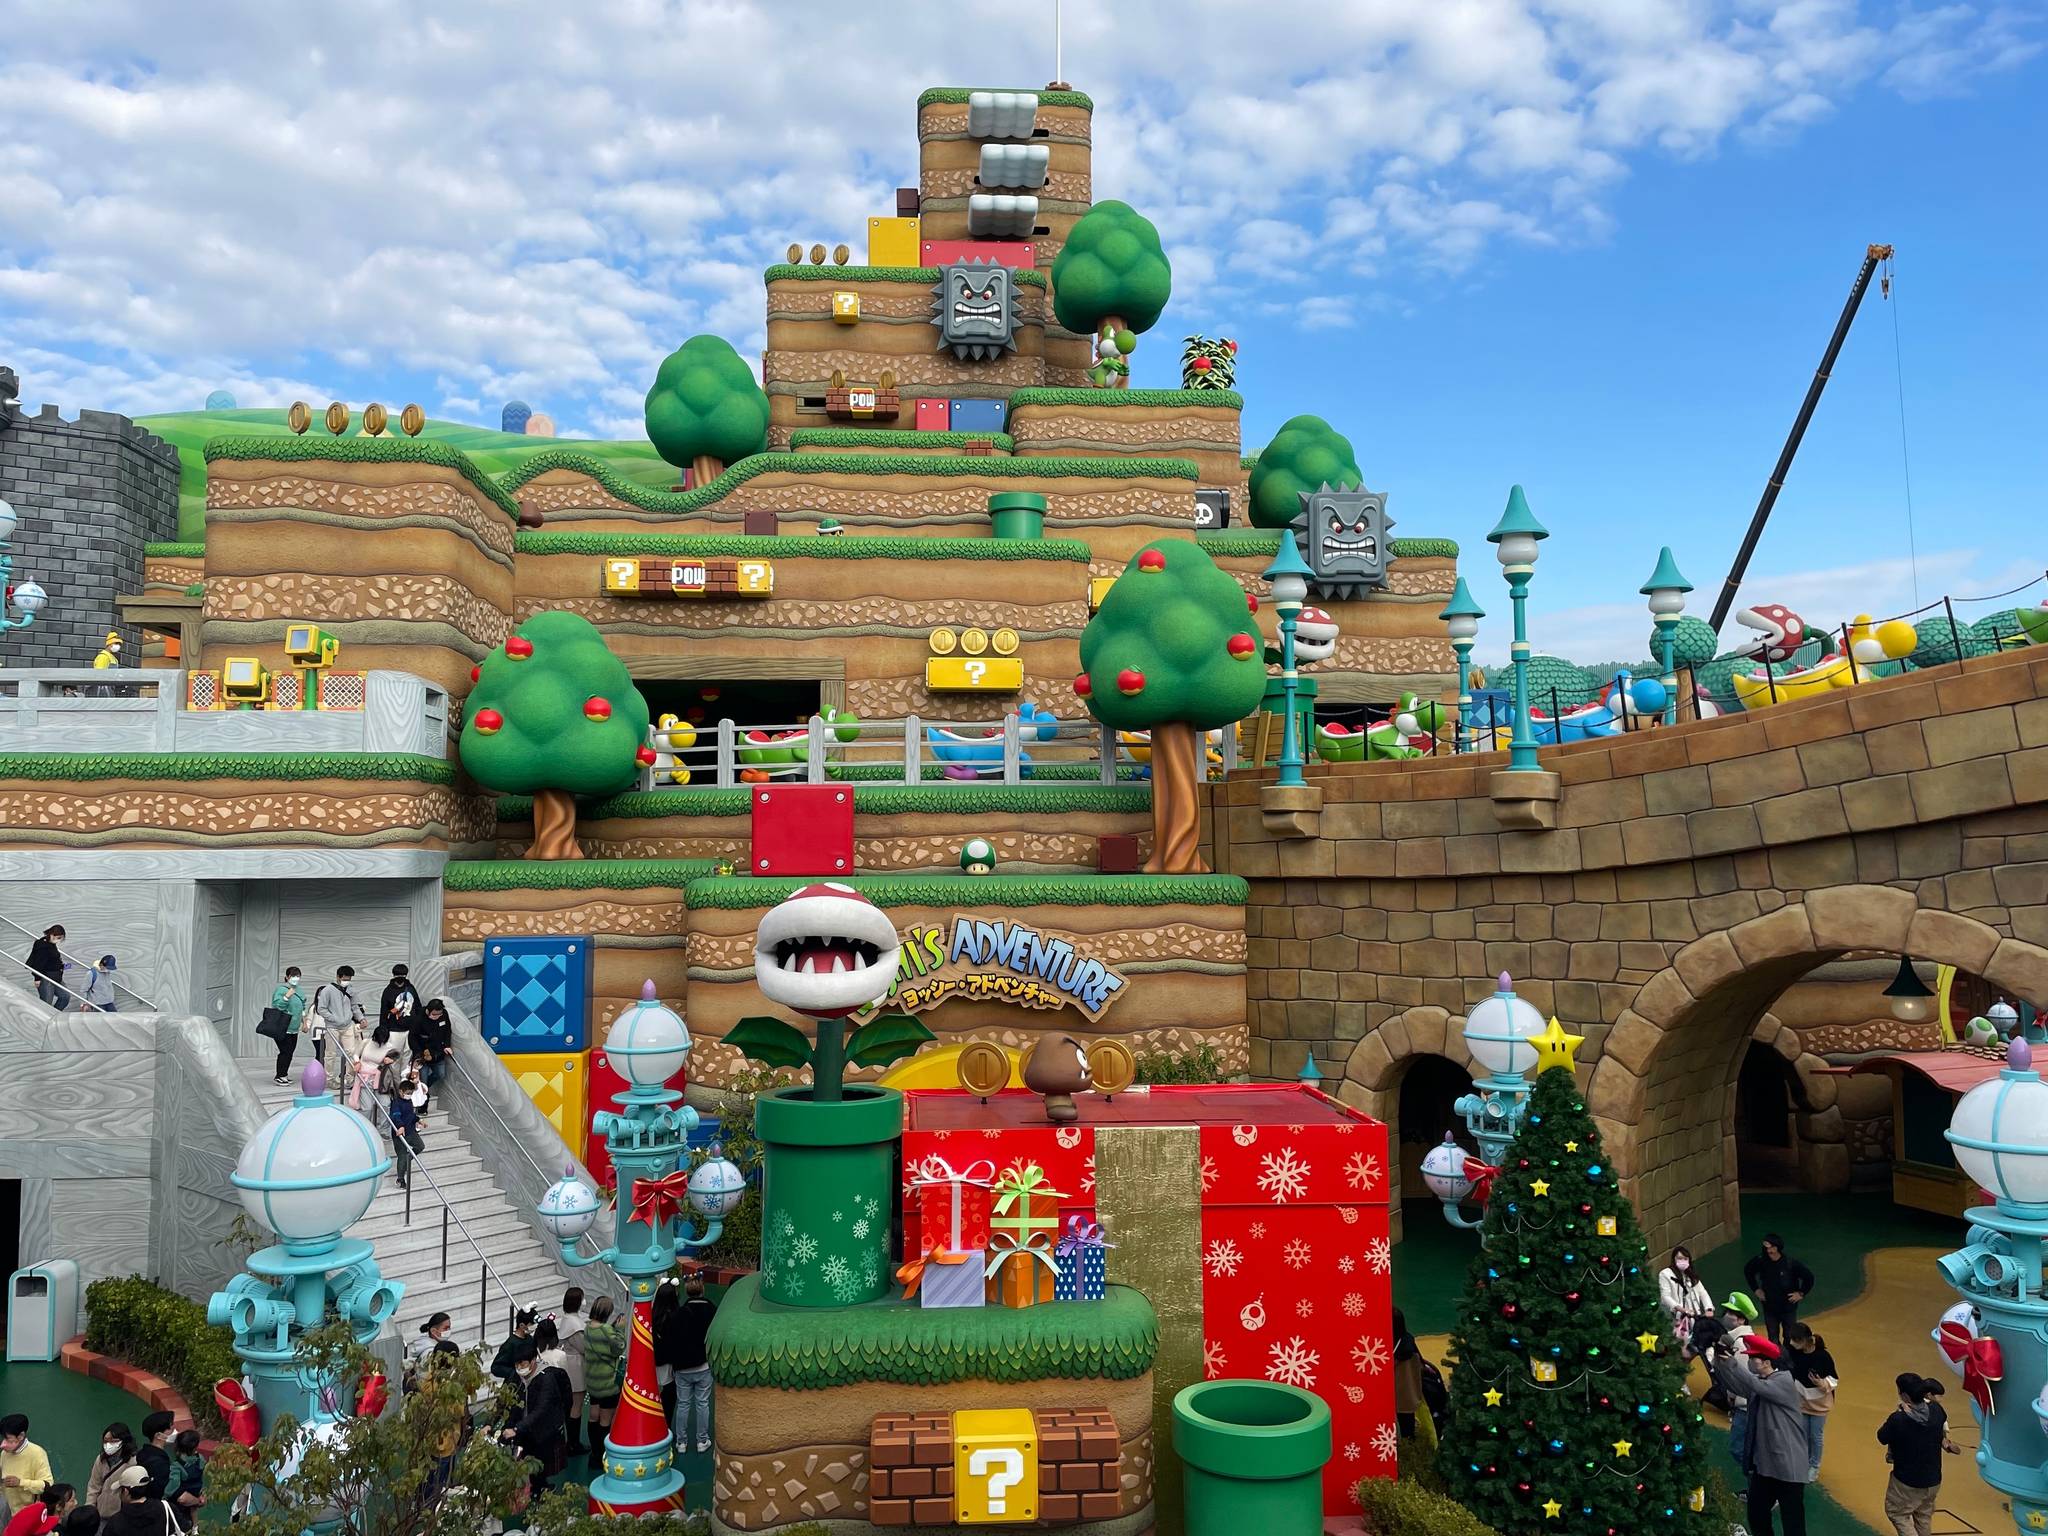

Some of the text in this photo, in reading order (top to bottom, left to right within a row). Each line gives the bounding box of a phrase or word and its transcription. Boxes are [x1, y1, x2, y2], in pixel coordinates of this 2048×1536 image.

[850, 393, 876, 408] POW
[611, 562, 765, 588] ? POW ?
[964, 661, 986, 685] ?
[951, 918, 1125, 1014] ADVENTURE
[901, 973, 1062, 1010] ヨッシー・アドベンチャー
[969, 1448, 1024, 1514] ?
